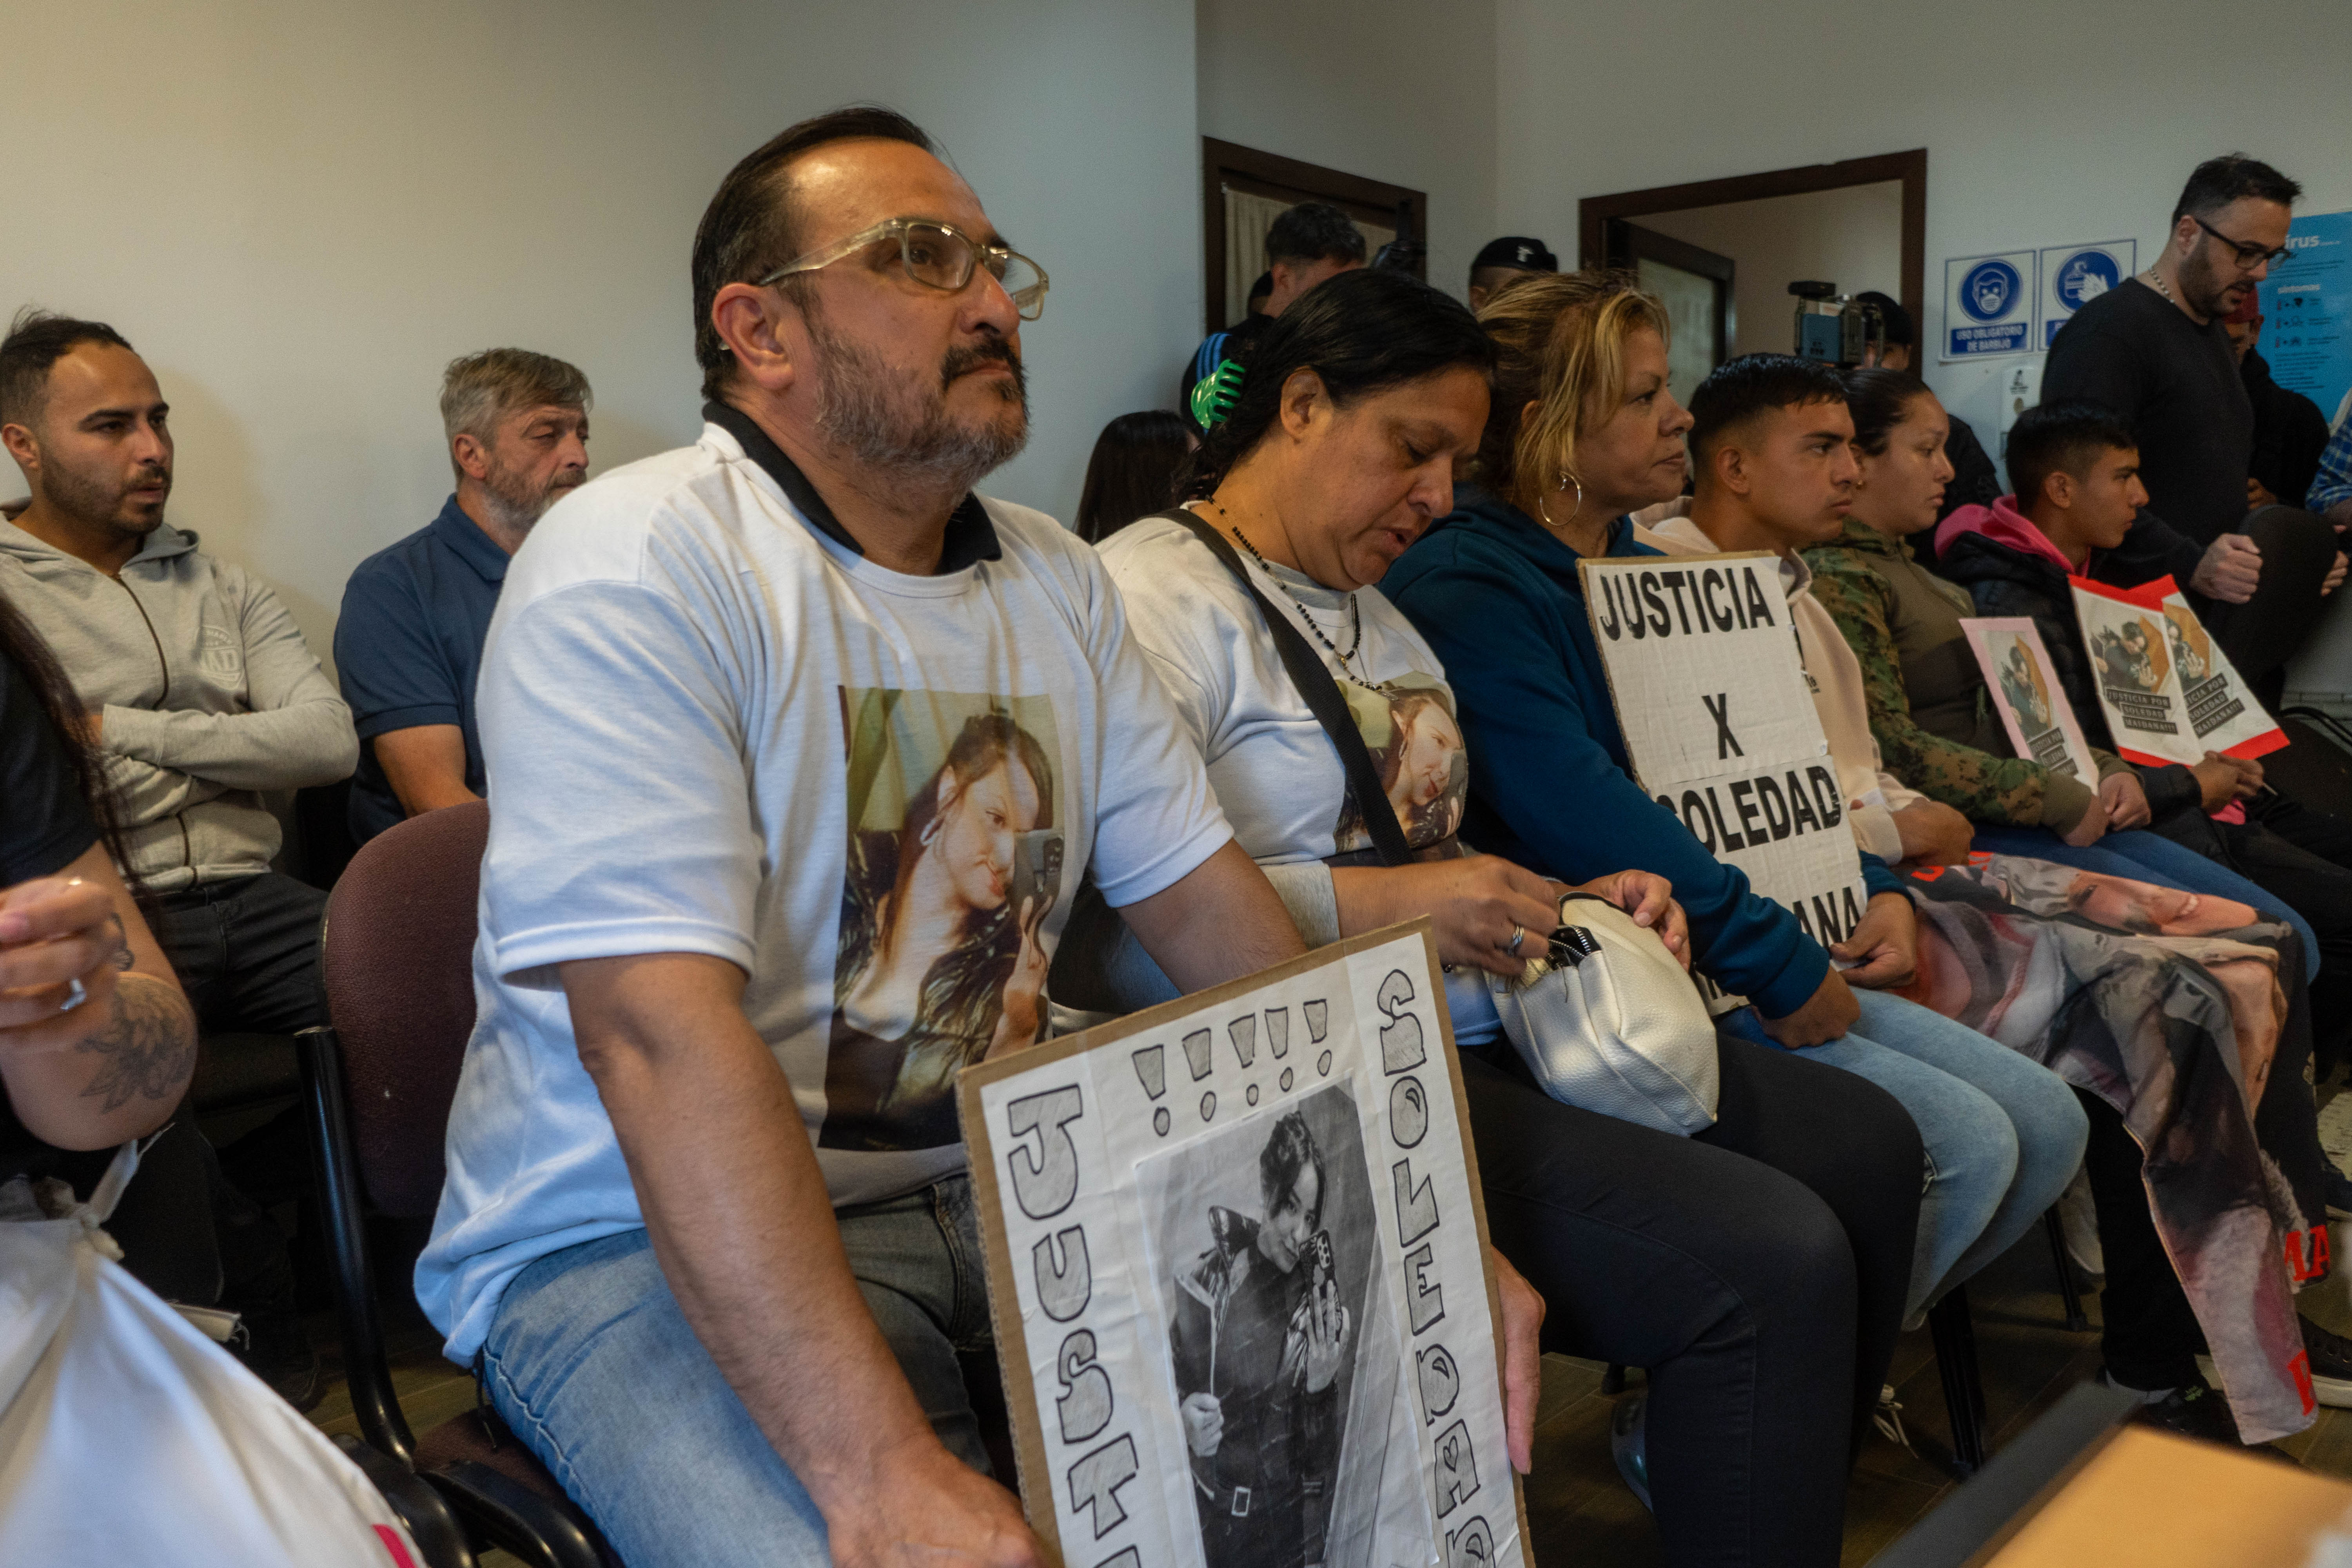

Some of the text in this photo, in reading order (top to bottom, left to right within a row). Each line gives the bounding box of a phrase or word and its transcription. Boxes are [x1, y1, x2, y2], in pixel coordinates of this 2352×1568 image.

[1600, 567, 1775, 641] JUSTICIA
[1702, 693, 1744, 760] X
[2108, 693, 2168, 706] JUSTICIA POR
[2124, 708, 2163, 718] SOLEDAD
[1793, 886, 1860, 953] ANA
